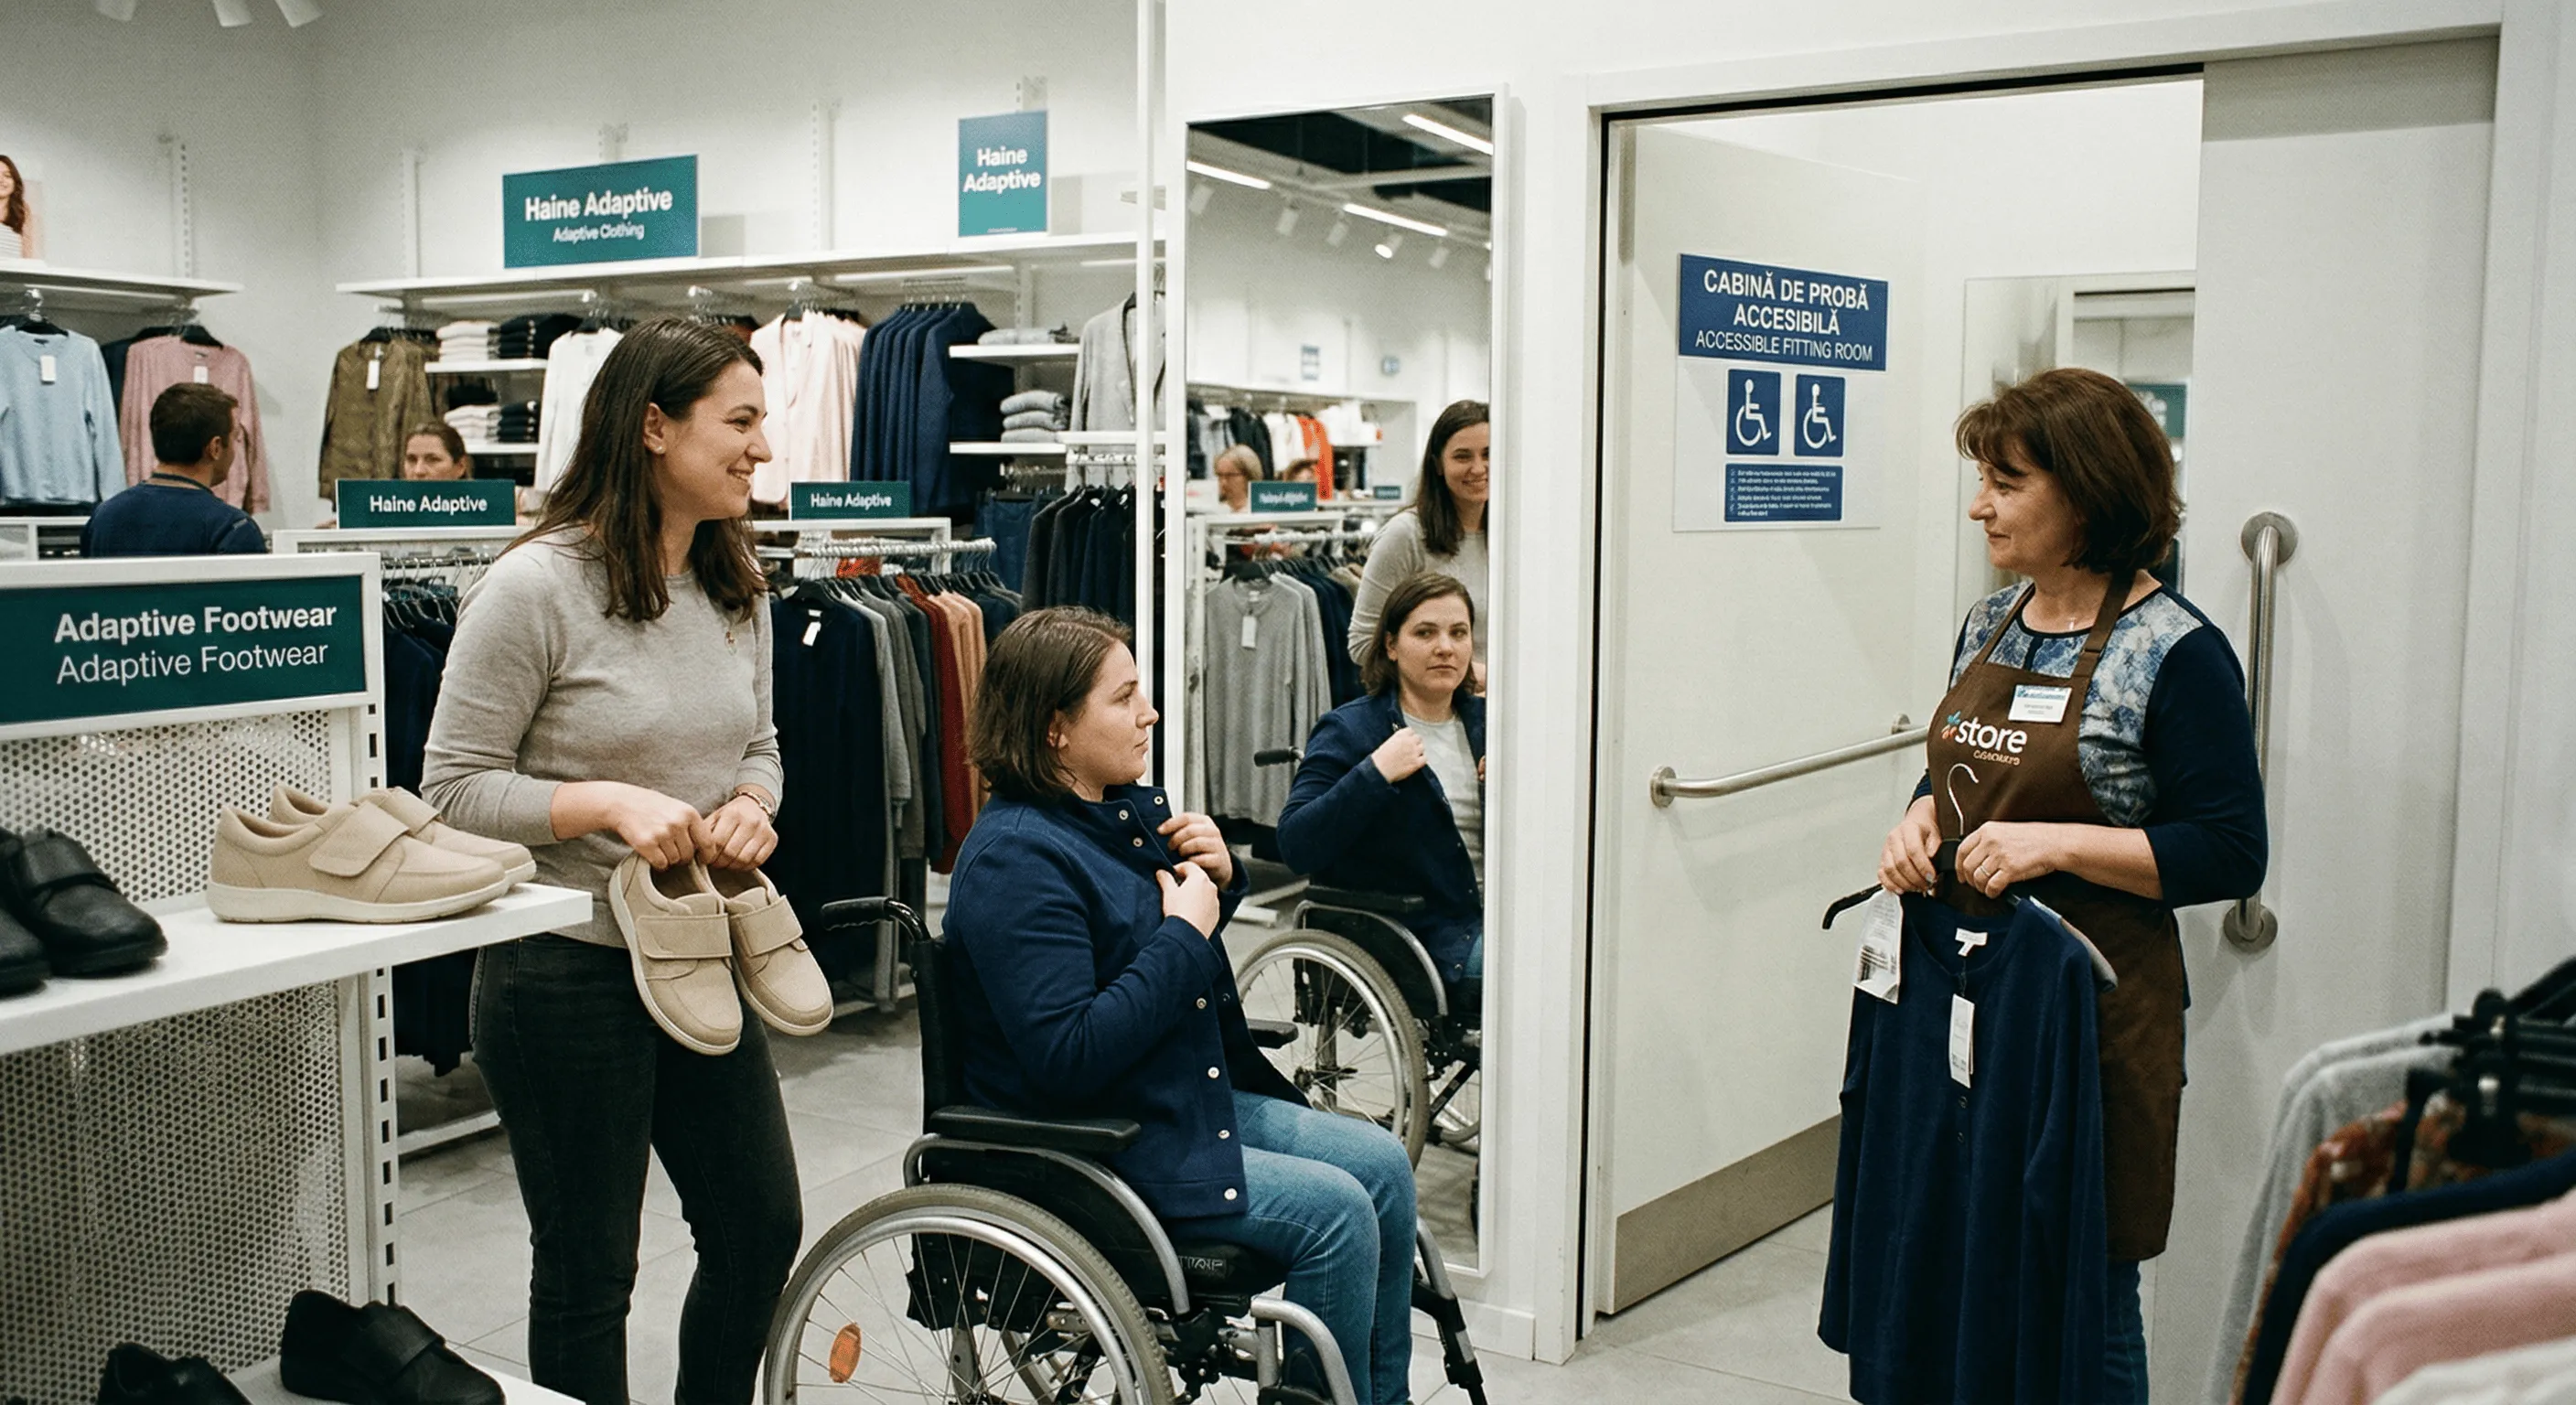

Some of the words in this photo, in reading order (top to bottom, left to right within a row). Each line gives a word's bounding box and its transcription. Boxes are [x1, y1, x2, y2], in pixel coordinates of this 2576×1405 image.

[977, 146, 1027, 166] Haine
[963, 168, 1041, 194] Adaptive
[524, 194, 581, 221] Haine
[584, 186, 673, 220] Adaptive
[553, 225, 599, 245] Adaptive
[600, 221, 645, 240] Clothing
[1703, 269, 1776, 300] CABINĂ
[1780, 278, 1805, 304] DE
[1809, 283, 1870, 311] PROBĂ
[1733, 304, 1841, 336] ACCESIBILĂ
[1695, 329, 1780, 355] ACCESSIBLE
[1783, 338, 1832, 359] FITTING
[1834, 342, 1873, 362] ROOM
[370, 495, 417, 512] Haine
[419, 494, 488, 516] Adaptive
[810, 492, 843, 508] Haine
[844, 492, 892, 510] Adaptive
[54, 609, 196, 646] Adaptive
[203, 606, 338, 634] Footwear
[57, 650, 192, 686] Adaptive
[201, 644, 328, 673] Footwear
[1954, 716, 2028, 754] store
